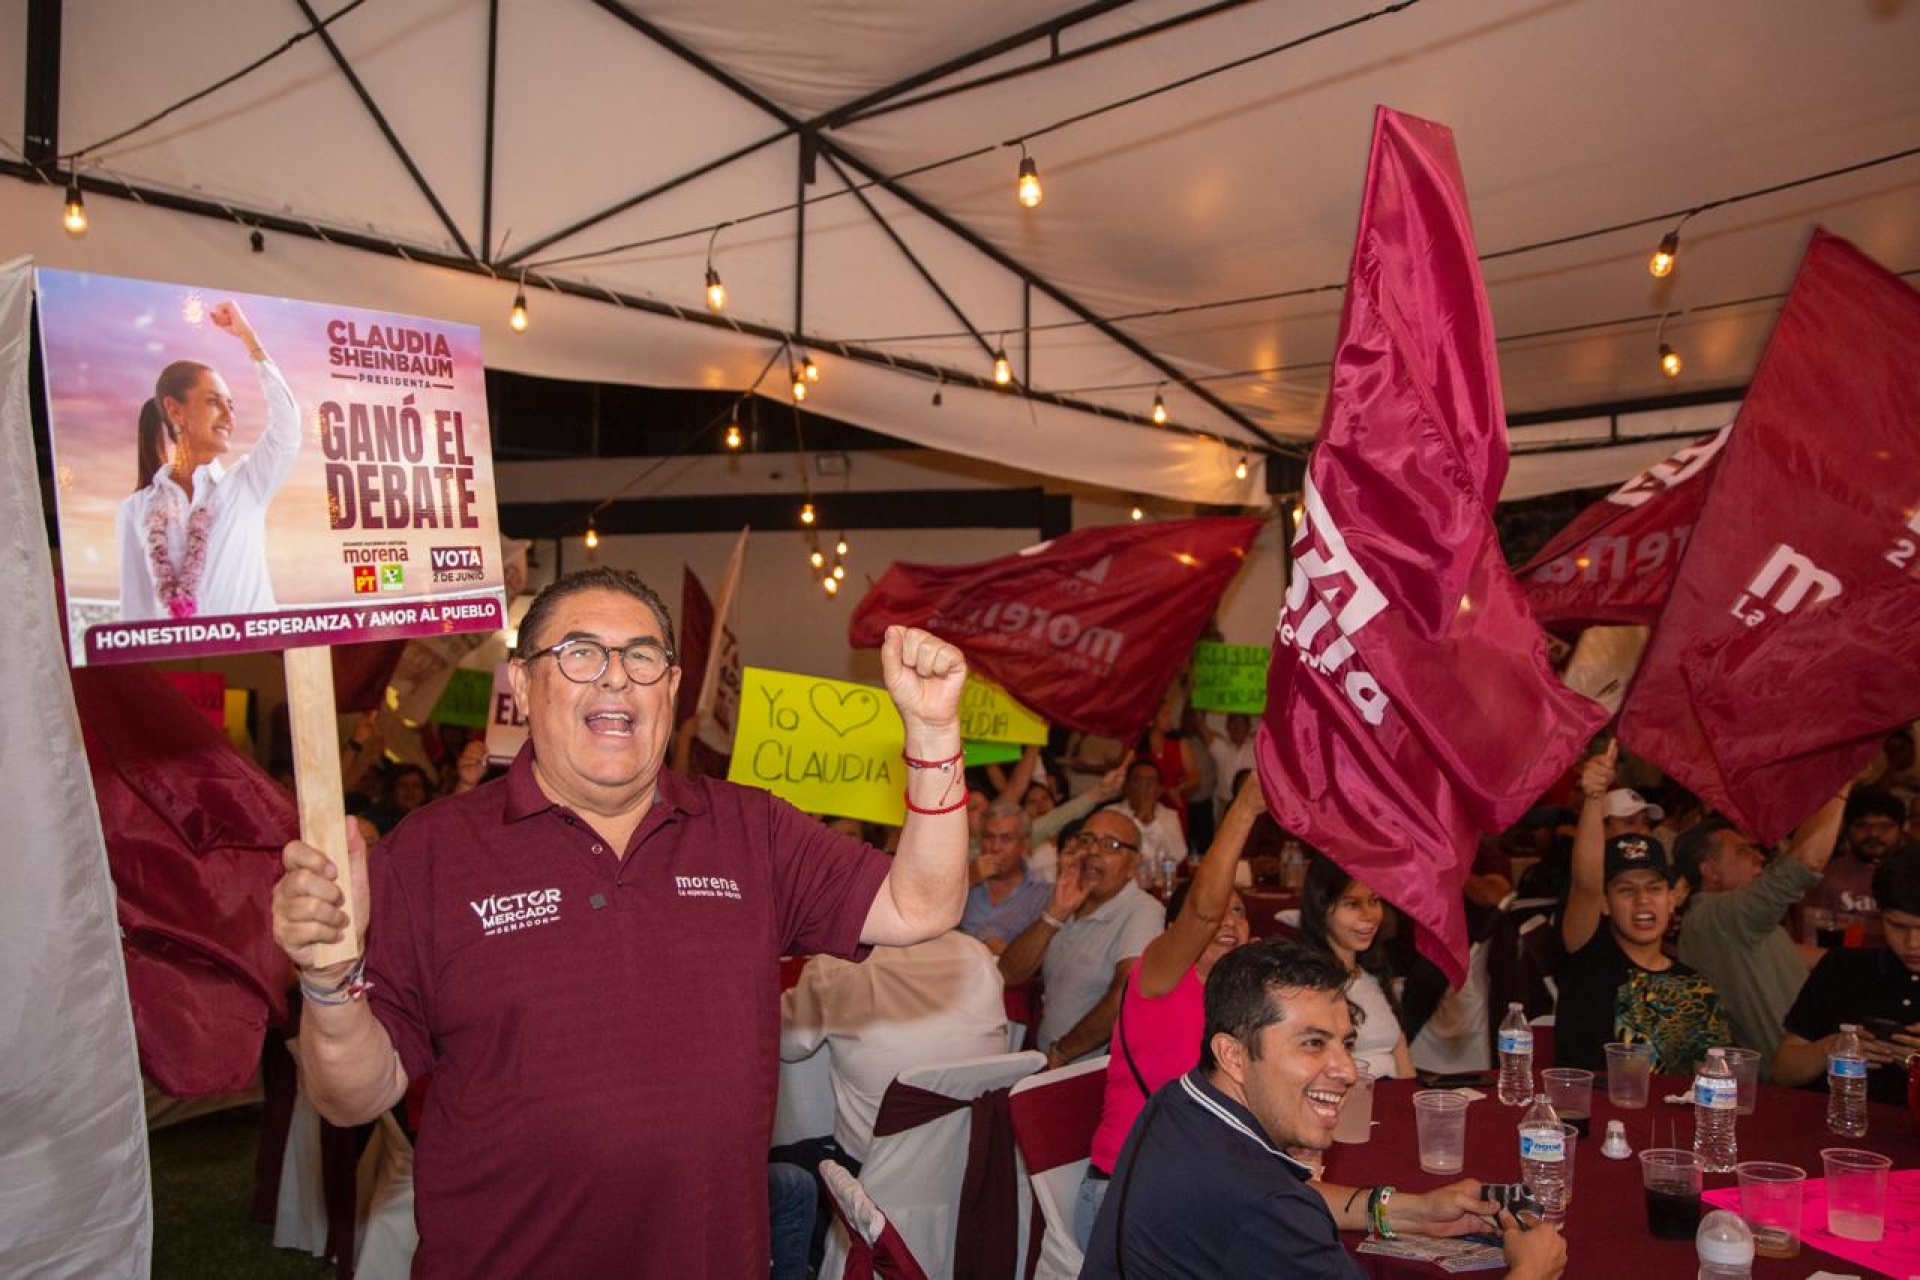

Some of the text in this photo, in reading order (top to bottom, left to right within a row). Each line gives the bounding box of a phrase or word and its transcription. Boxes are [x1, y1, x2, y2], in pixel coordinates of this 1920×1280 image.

[328, 320, 451, 357] CLAUDIA
[329, 346, 454, 378] SHEINBAUM
[359, 373, 432, 388] PRESIDENTA
[319, 392, 475, 466] GANÓ EL
[325, 463, 479, 530] DEBATE
[343, 546, 409, 564] morena
[433, 550, 481, 568] VOTA
[356, 575, 376, 592] PT
[433, 570, 484, 583] 2 DE JUNIO
[95, 603, 496, 650] HONESTIDAD, ESPERANZA Y AMOR AL PUEBLO
[1731, 597, 1765, 628] La
[759, 684, 800, 732] Yo
[752, 739, 892, 786] CLAUDIA
[675, 876, 739, 891] morena
[470, 887, 562, 918] VÍCTOR
[482, 904, 559, 930] MERCADO
[496, 917, 550, 935] SENADOR
